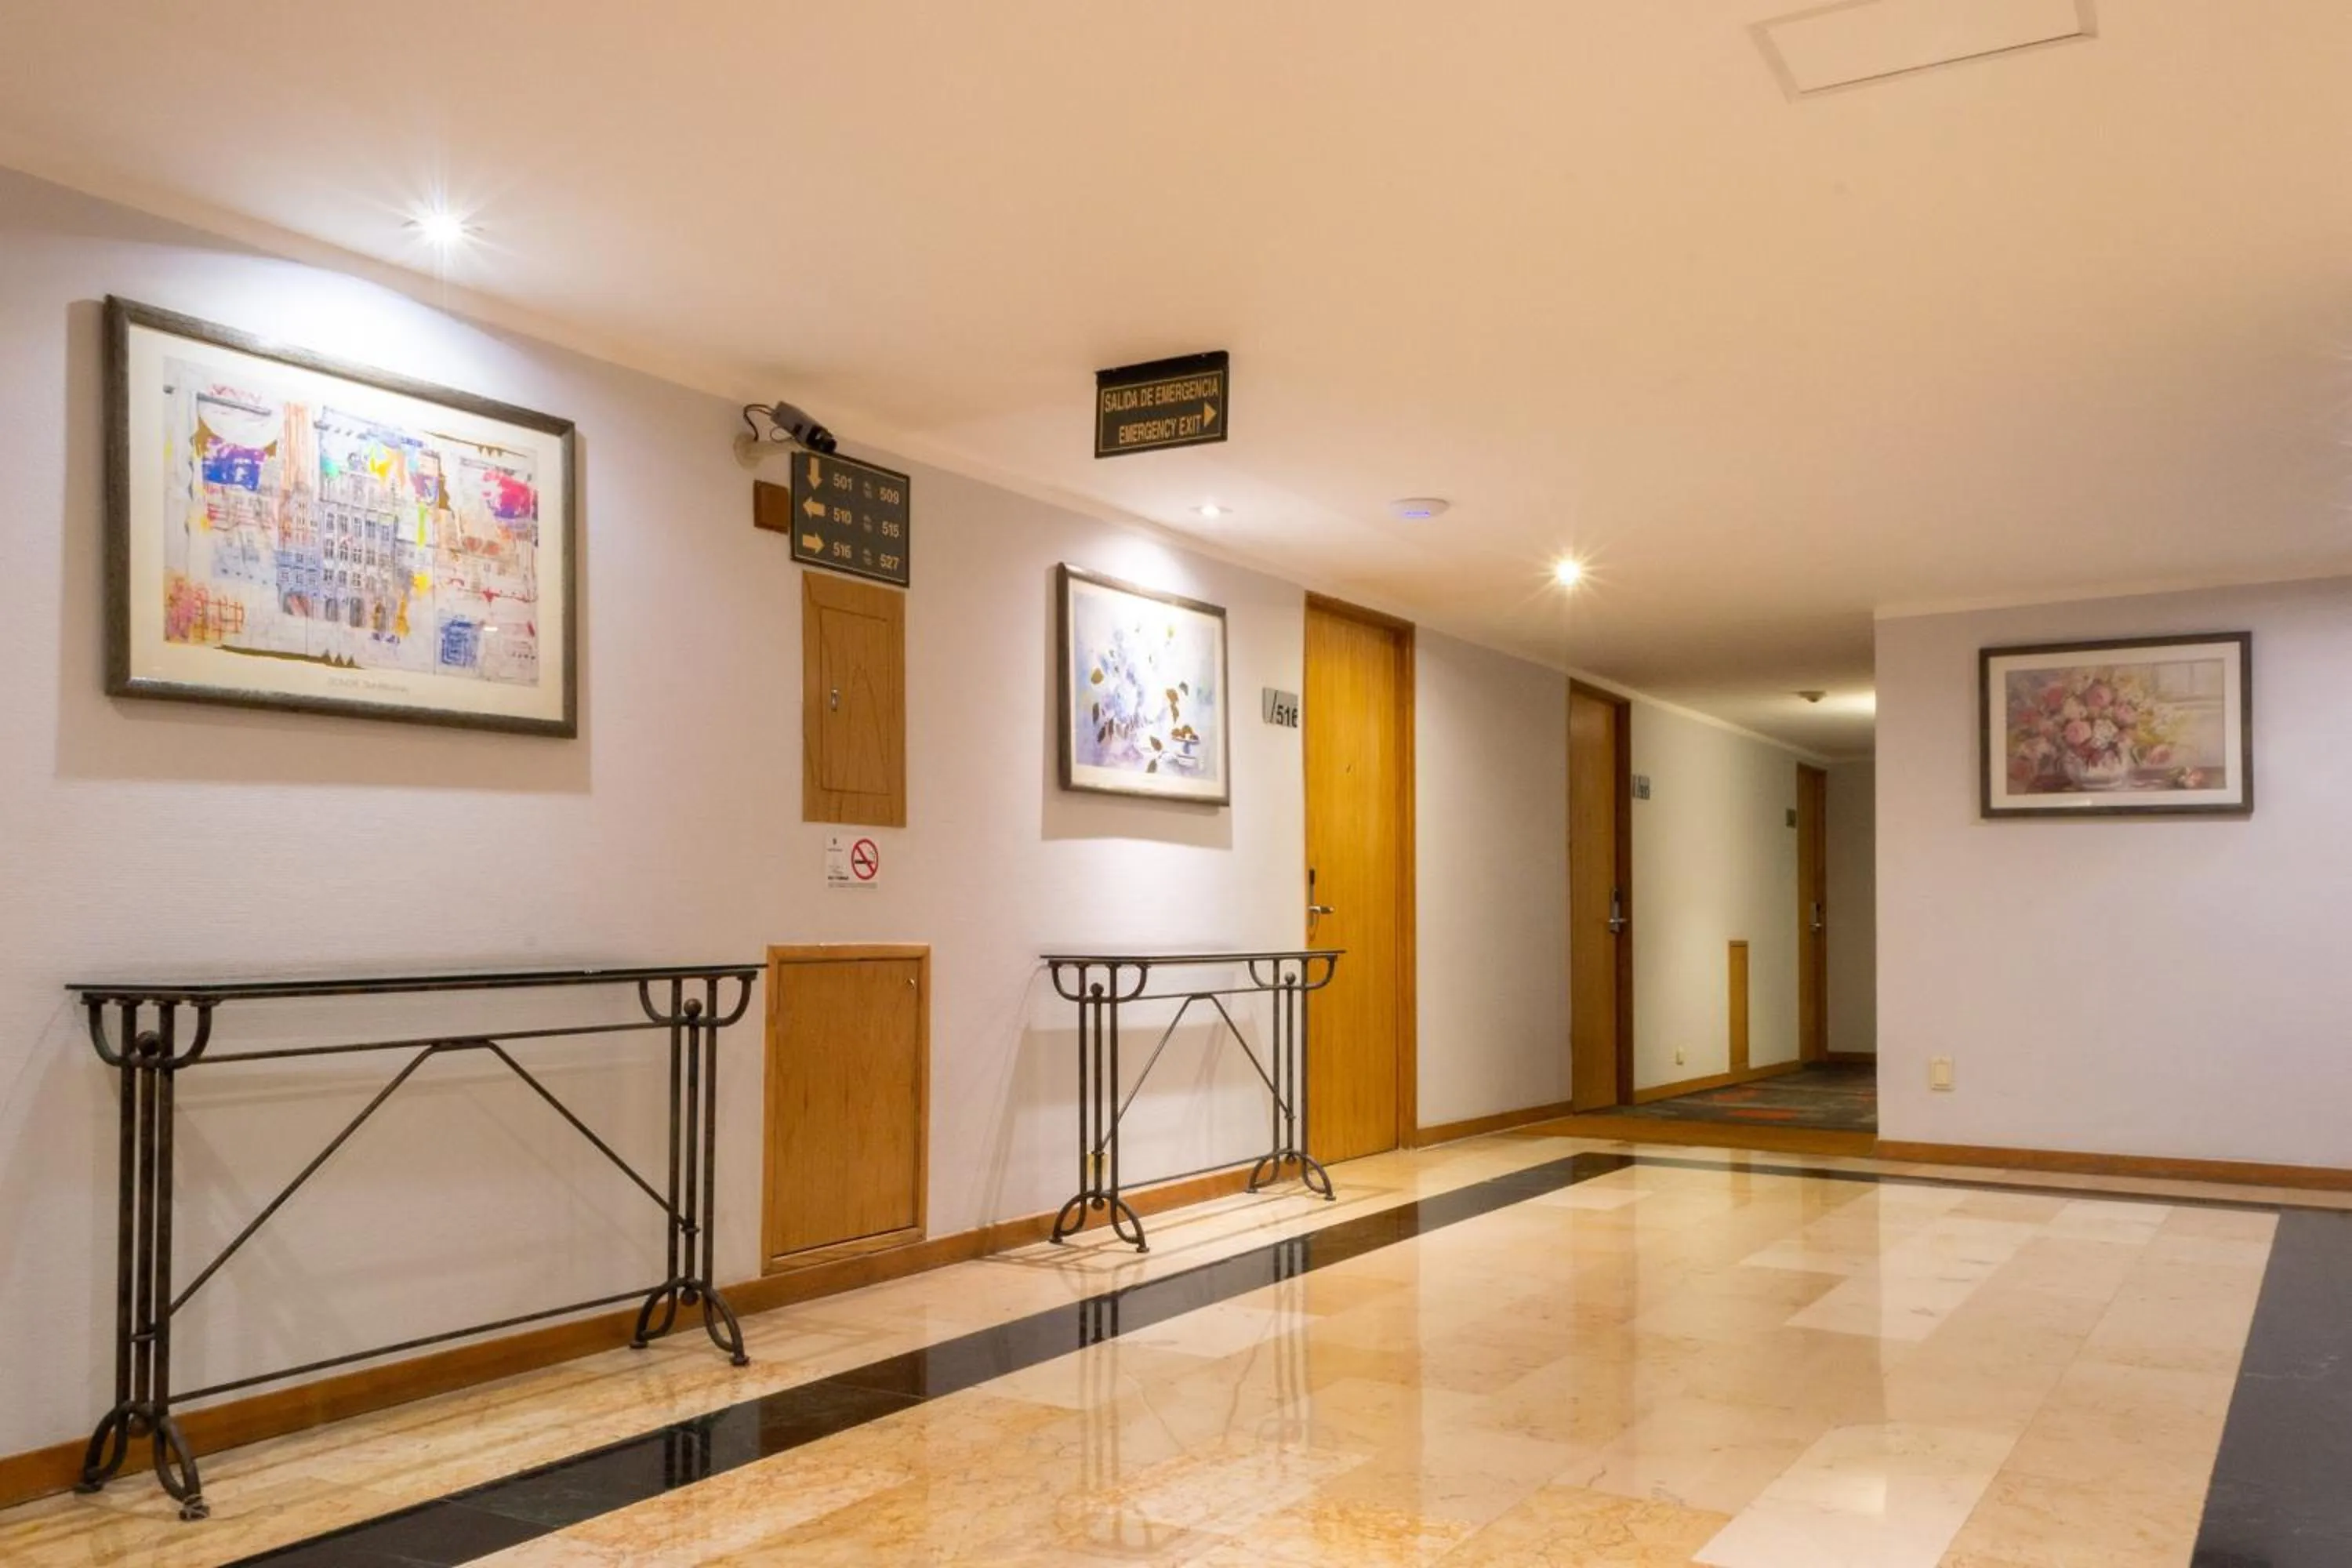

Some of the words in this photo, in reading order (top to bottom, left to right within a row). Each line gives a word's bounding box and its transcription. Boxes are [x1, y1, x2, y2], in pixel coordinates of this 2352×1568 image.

[1104, 390, 1138, 412] SALIDA
[1141, 387, 1154, 406] DE
[1156, 379, 1219, 405] EMERGENCIA
[1119, 419, 1177, 444] EMERGENCY
[1179, 415, 1202, 436] EXIT
[833, 473, 853, 492] 501
[879, 487, 899, 504] 509
[833, 507, 852, 524] 510
[881, 521, 899, 538] 515
[833, 542, 852, 559] 516
[880, 553, 899, 570] 527
